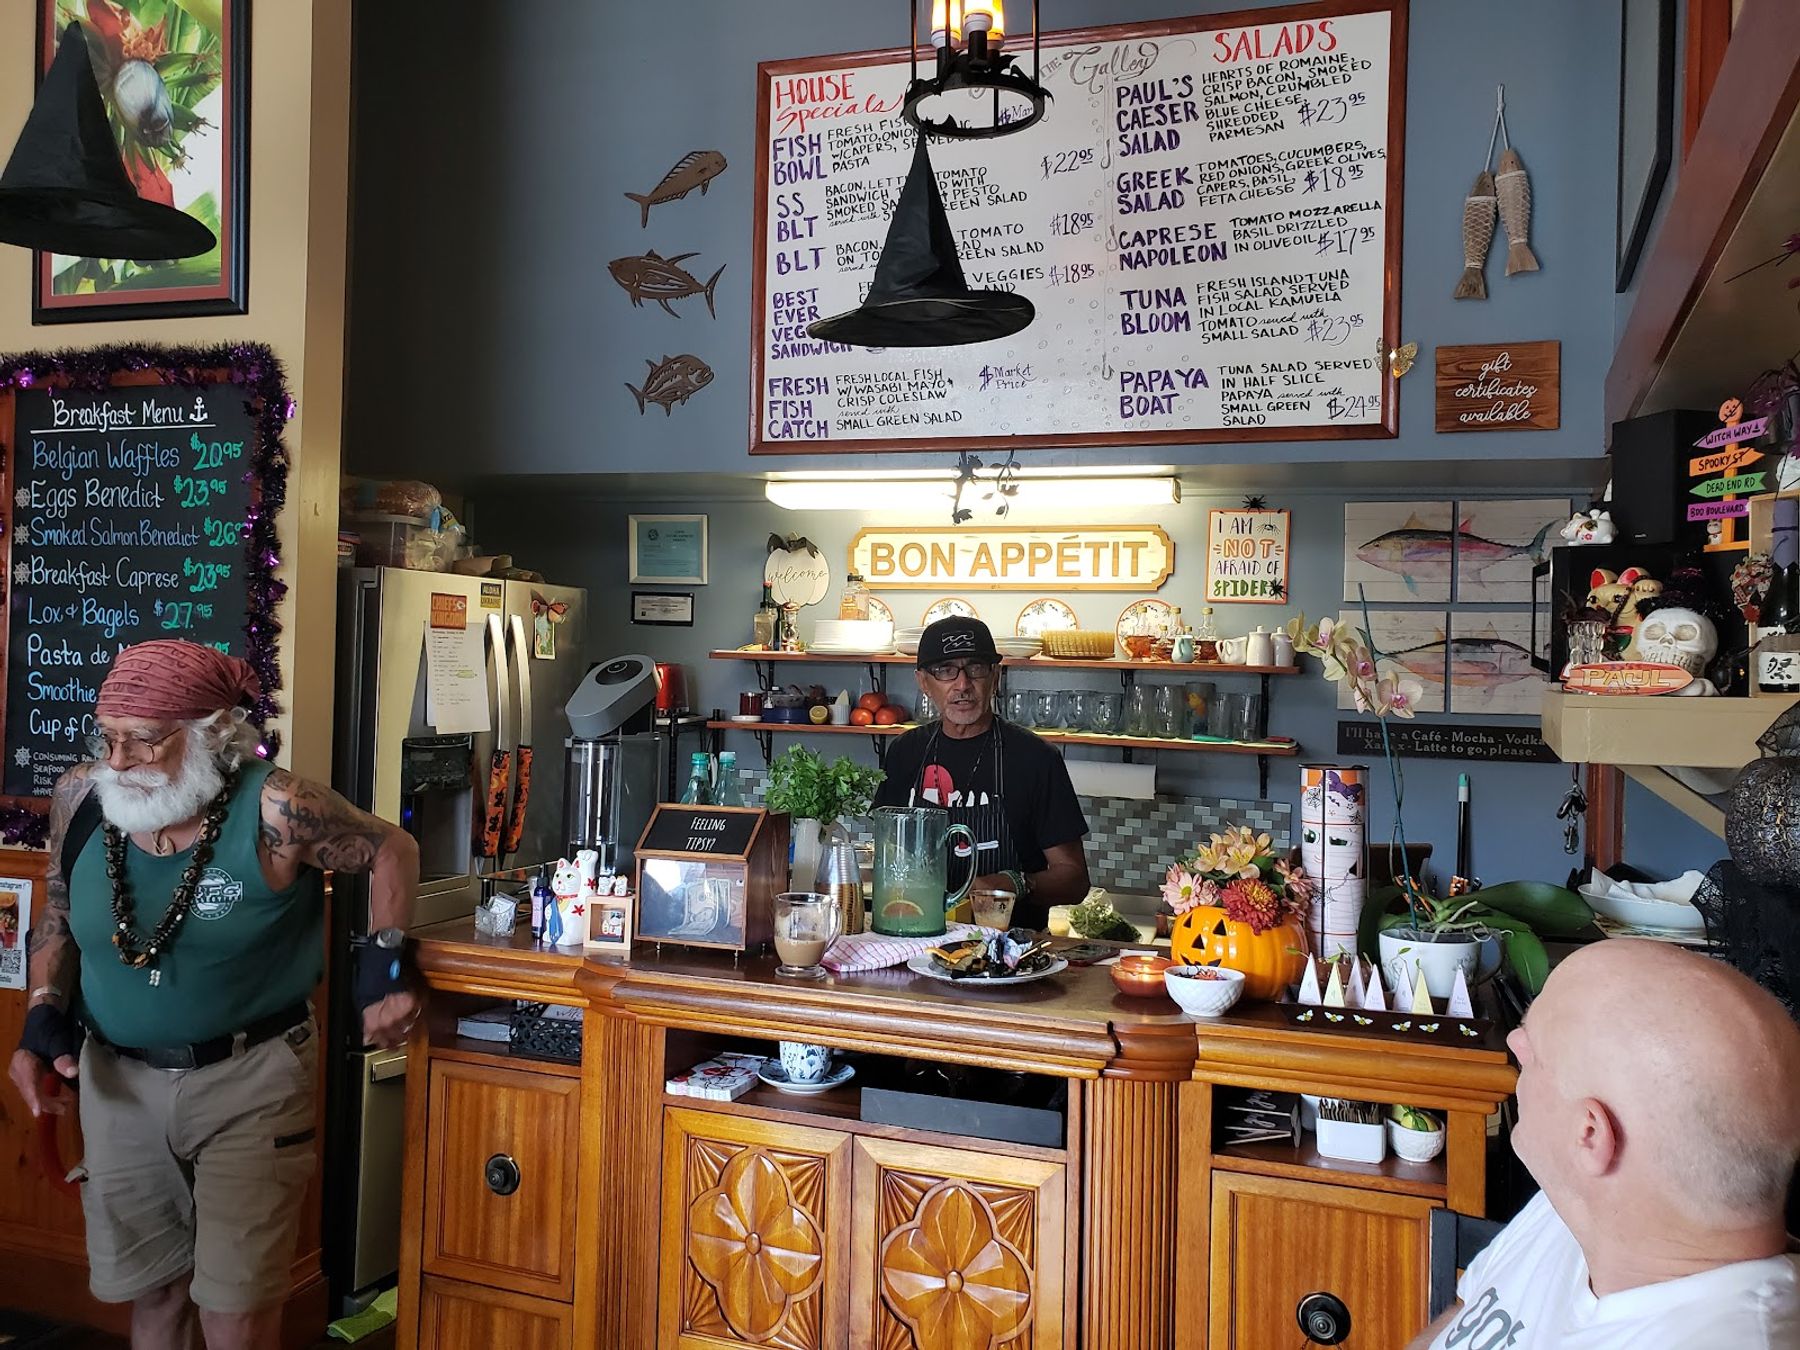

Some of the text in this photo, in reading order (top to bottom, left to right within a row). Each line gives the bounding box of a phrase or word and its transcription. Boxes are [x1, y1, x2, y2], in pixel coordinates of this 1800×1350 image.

[1213, 20, 1337, 64] SALADS
[1202, 66, 1253, 84] HEARTS
[1256, 62, 1275, 75] OF
[1202, 80, 1242, 96] CRISP
[1308, 60, 1372, 79] SMOKED
[775, 72, 855, 109] HOUSE
[1116, 74, 1193, 108] PAUL'S
[1266, 73, 1352, 97] CRUMBLED
[776, 93, 903, 135] Specials
[1116, 101, 1199, 132] CAESER
[1205, 104, 1240, 120] BLUE
[1206, 110, 1279, 132] SHREDDED
[828, 121, 873, 140] FRESH
[1210, 119, 1284, 142] PARMESAN
[773, 133, 821, 161] FISH
[1119, 129, 1181, 157] SALAD
[774, 156, 827, 186] BOWL
[832, 157, 870, 173] PASTA
[935, 167, 987, 180] TOMATO
[1200, 170, 1226, 184] RED
[1286, 155, 1334, 171] GREEK
[1116, 166, 1194, 193] GREEK
[826, 175, 985, 209] SANDWICH WITH
[827, 184, 999, 220] SMOKED PESTO
[987, 191, 1027, 206] SALAD
[1117, 189, 1185, 215] SALAD
[1199, 183, 1294, 207] FETA CHEESE
[776, 192, 804, 218] SS
[1229, 200, 1382, 229] TOMATO MOZZARELLA
[777, 216, 818, 242] BLT
[957, 223, 1024, 240] TOMATO
[1119, 223, 1217, 249] CAPRESE
[1233, 216, 1348, 241] BASIL DRIZZLED
[1001, 241, 1044, 257] SALAD
[1119, 241, 1227, 271] NAPOLEON
[1234, 242, 1249, 253] IN
[776, 247, 827, 275] BLT
[972, 267, 1044, 283] VEGGIES
[1196, 268, 1350, 294] FRESH ISLAND TUNA
[773, 288, 819, 309] BEST
[1120, 287, 1187, 310] TUNA
[1197, 281, 1349, 305] FISH SALAD SERVED
[774, 305, 821, 326] EVER
[1199, 292, 1342, 319] IN LOCAL KAMUELA
[1121, 311, 1191, 335] BLOOM
[1197, 316, 1258, 332] TOMATO
[1202, 325, 1299, 345] SMALL SALAD
[836, 368, 943, 385] FRESH LOCAL FISH
[1218, 358, 1373, 375] TUNA SALAD SERVED
[1478, 352, 1512, 381] gift
[768, 376, 829, 397] FRESH
[1120, 368, 1209, 393] PAPAYA
[1222, 373, 1326, 389] IN HALF SLICE
[1455, 378, 1537, 399] certificates
[837, 389, 947, 408] CRISP COLESLAW
[1120, 392, 1180, 419] BOAT
[1221, 388, 1273, 401] PAPAYA
[52, 398, 185, 433] Breakfast Menu
[769, 399, 813, 419] FISH
[1221, 400, 1311, 415] SMALL GREEN
[1460, 400, 1531, 422] available
[768, 420, 829, 439] CATCH
[836, 410, 962, 431] SMALL GREEN SALAD
[1222, 414, 1266, 427] SALAD
[1706, 425, 1752, 445] WITCH WAY
[32, 438, 99, 481] Belgian
[106, 438, 180, 477] Waffles
[1698, 455, 1731, 472] SPOOKY
[1706, 476, 1756, 494] DEAD END RD
[31, 479, 77, 519] Eggs
[85, 477, 165, 509] Benedict
[31, 516, 200, 547] Smoked Salmon Benedict
[1229, 517, 1253, 535] AM
[870, 535, 1149, 577] BON APPÉTIT
[1223, 539, 1275, 558] NOT
[31, 554, 111, 594] Breakfast
[116, 556, 179, 594] Caprese
[1214, 560, 1280, 575] AFRAID OF
[28, 597, 63, 624] Lox
[82, 597, 139, 638] Bagels
[27, 633, 110, 666] Pasta de
[1582, 669, 1670, 687] PAUL
[29, 708, 78, 742] Cup of
[1411, 730, 1442, 742] Café
[1452, 731, 1494, 744] Mocha
[1415, 741, 1447, 753] Latte
[1451, 744, 1464, 753] to
[690, 817, 727, 831] FEELING
[685, 837, 716, 852] TIPSY?
